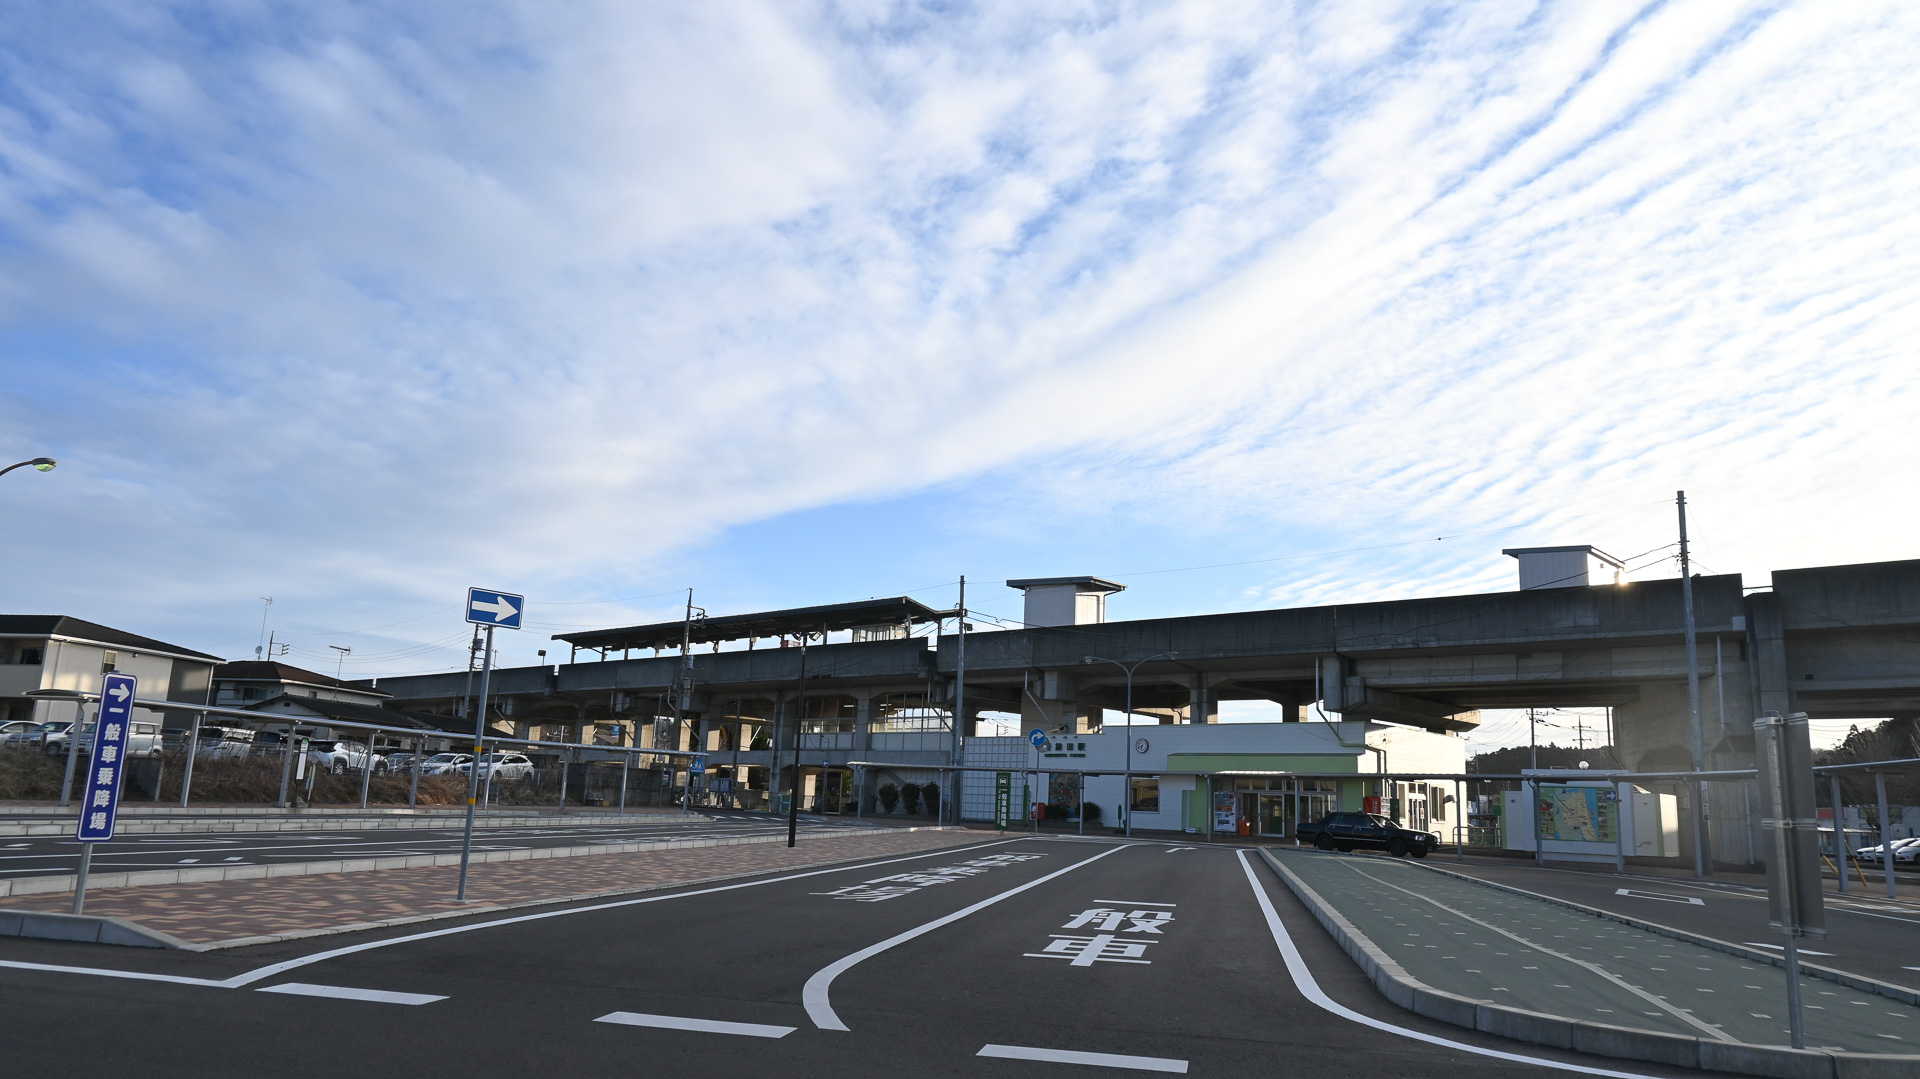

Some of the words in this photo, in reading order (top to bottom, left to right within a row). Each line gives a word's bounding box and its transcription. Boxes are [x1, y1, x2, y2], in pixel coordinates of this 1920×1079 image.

[89, 707, 124, 830] 一般車乗降場
[1022, 899, 1177, 967] 一般車
